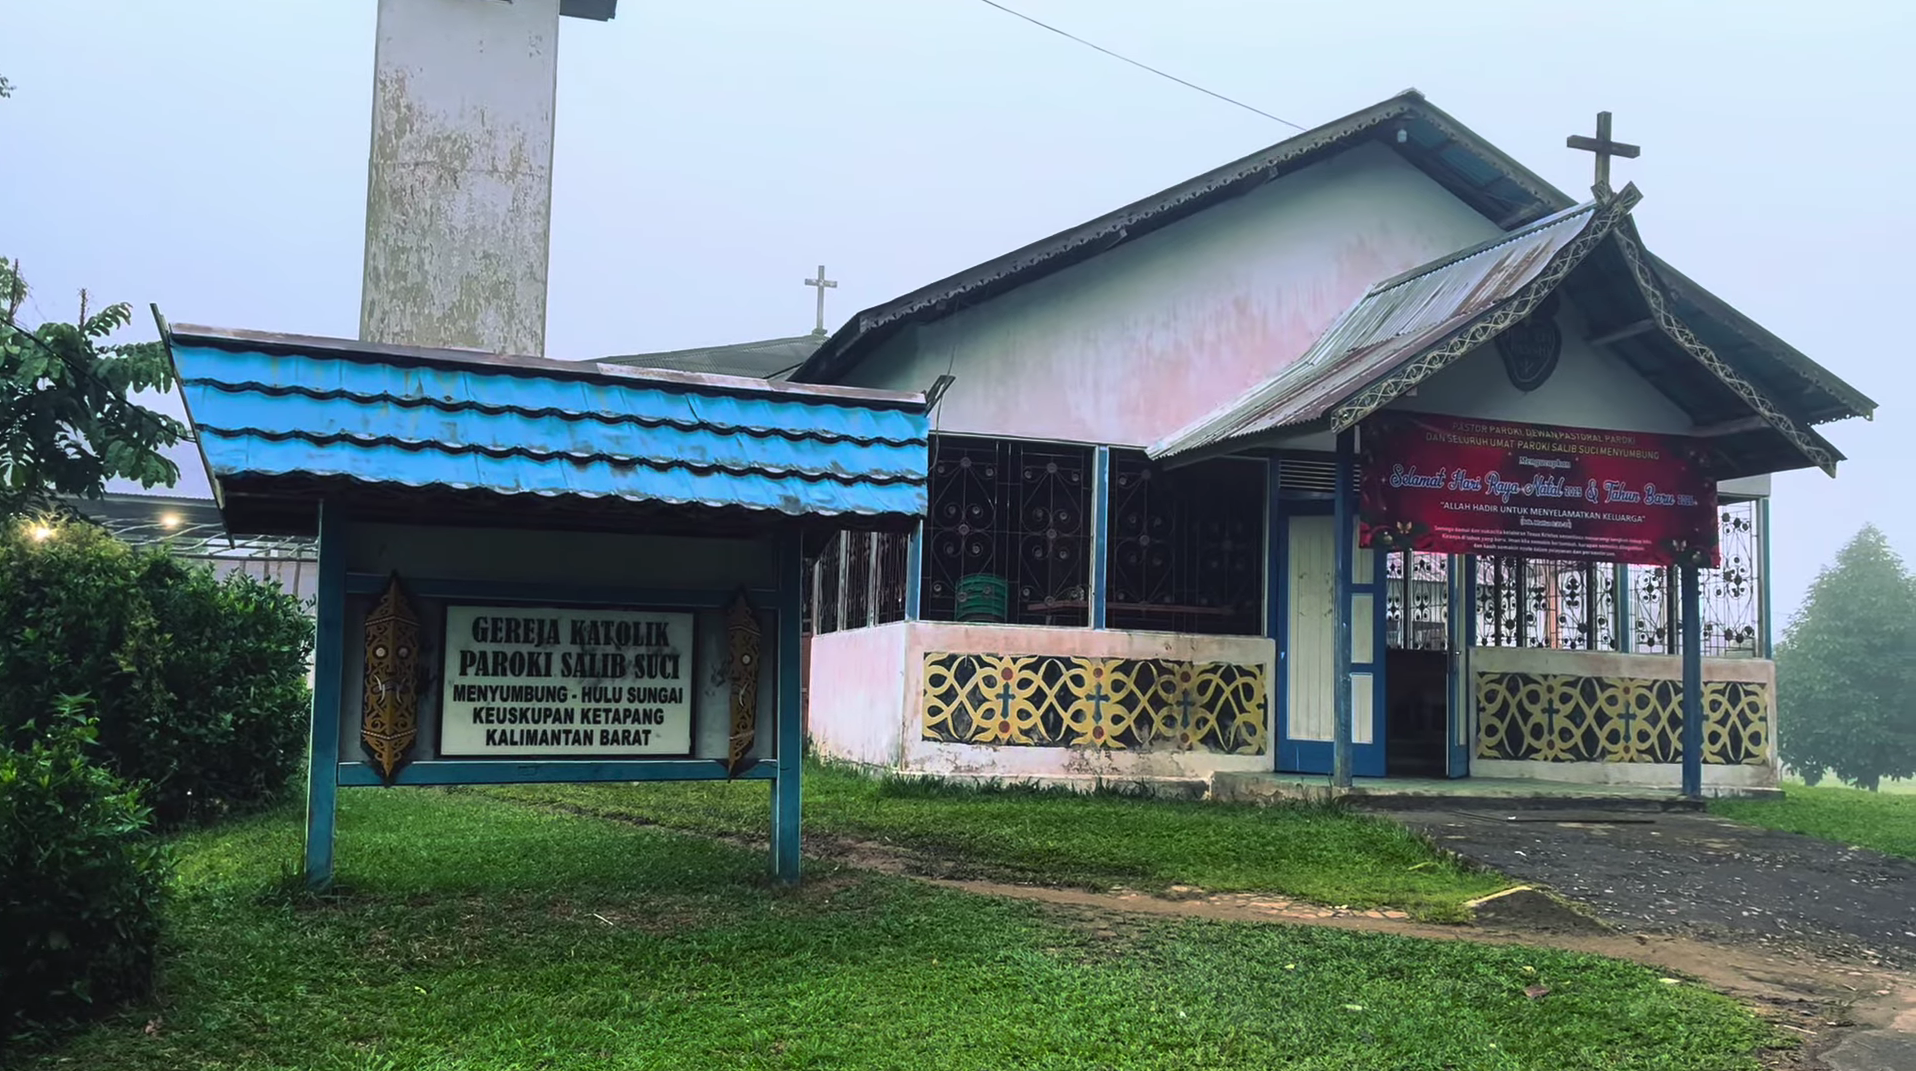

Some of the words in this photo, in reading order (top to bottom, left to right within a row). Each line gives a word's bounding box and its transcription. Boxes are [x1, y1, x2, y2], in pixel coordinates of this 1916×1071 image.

[1452, 422, 1488, 433] PASTOR
[1559, 432, 1602, 442] PASTORAL
[1605, 435, 1636, 445] PAROKI
[1426, 432, 1446, 442] DAN
[1447, 434, 1488, 446] SELURUH
[1490, 438, 1514, 448] UMAT
[1518, 440, 1550, 451] PAROKI
[1551, 442, 1576, 453] SALIB
[1578, 445, 1599, 455] SUCI
[1600, 447, 1660, 460] MENYUMBUNG
[1390, 464, 1446, 488] Selamat
[1448, 468, 1482, 491] Hari
[1484, 470, 1520, 504] Raya
[1522, 474, 1565, 497] Natal
[1585, 478, 1599, 504] &
[1603, 480, 1640, 504] Tahun
[1644, 483, 1676, 506] Baru
[1472, 504, 1498, 513] HADIR
[1500, 506, 1528, 514] UNTUK
[1530, 508, 1600, 520] MENYELAMATKAN
[472, 616, 560, 648] GEREJA
[570, 619, 670, 649] KATOLIK
[459, 650, 552, 678] PAROKI
[561, 652, 626, 679] SALIB
[634, 653, 680, 680] SUCI
[453, 684, 568, 703] MENYUMBUNG
[582, 687, 623, 704] HULU
[627, 687, 683, 704] SUNGAI
[473, 706, 575, 724] KEUSKUPAN
[580, 708, 664, 724] KETAPANG
[486, 729, 594, 746] KALIMANTAN
[600, 730, 652, 746] BARAT
